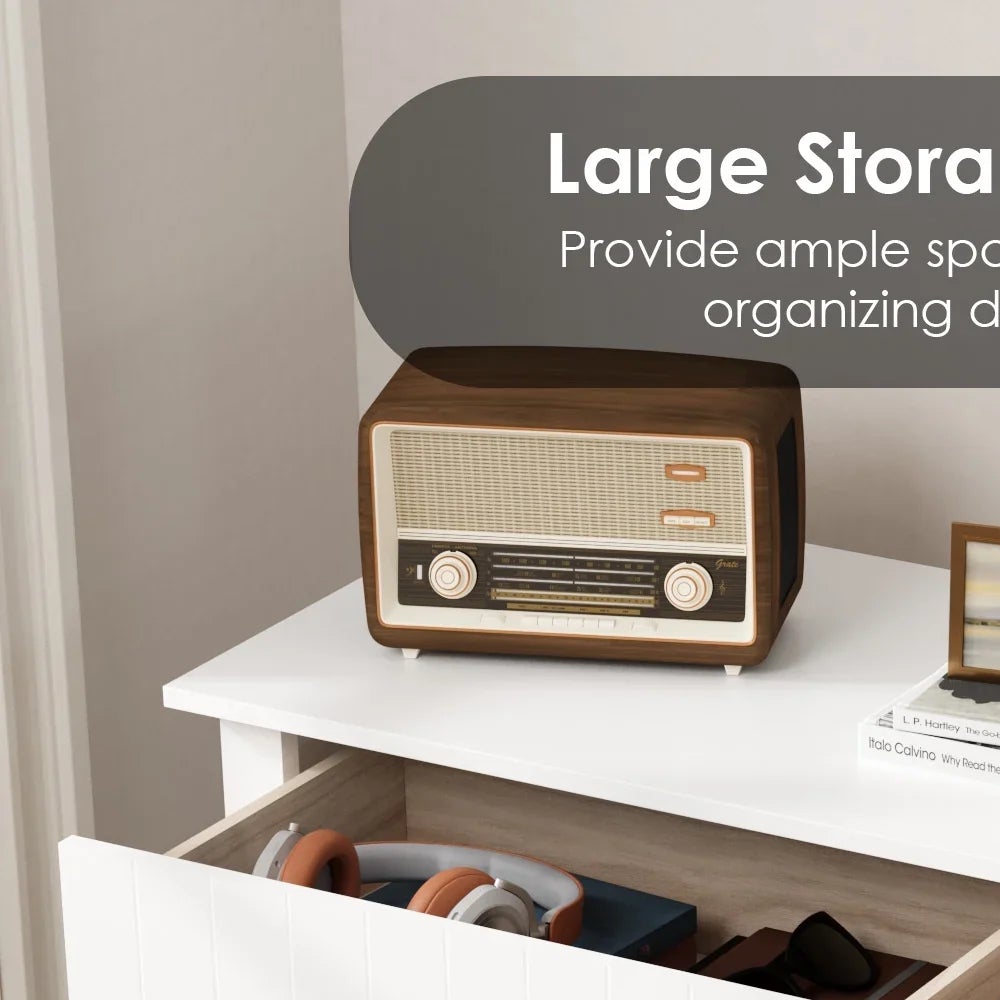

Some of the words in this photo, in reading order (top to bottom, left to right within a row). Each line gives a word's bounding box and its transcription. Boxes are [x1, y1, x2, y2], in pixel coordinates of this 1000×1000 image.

[903, 715, 910, 725] L.
[913, 717, 923, 726] P.
[924, 719, 961, 734] Hartley
[965, 726, 981, 736] The
[868, 736, 892, 753] Italo
[894, 742, 937, 762] Calvino
[941, 753, 961, 768] Why
[962, 758, 986, 773] Read
